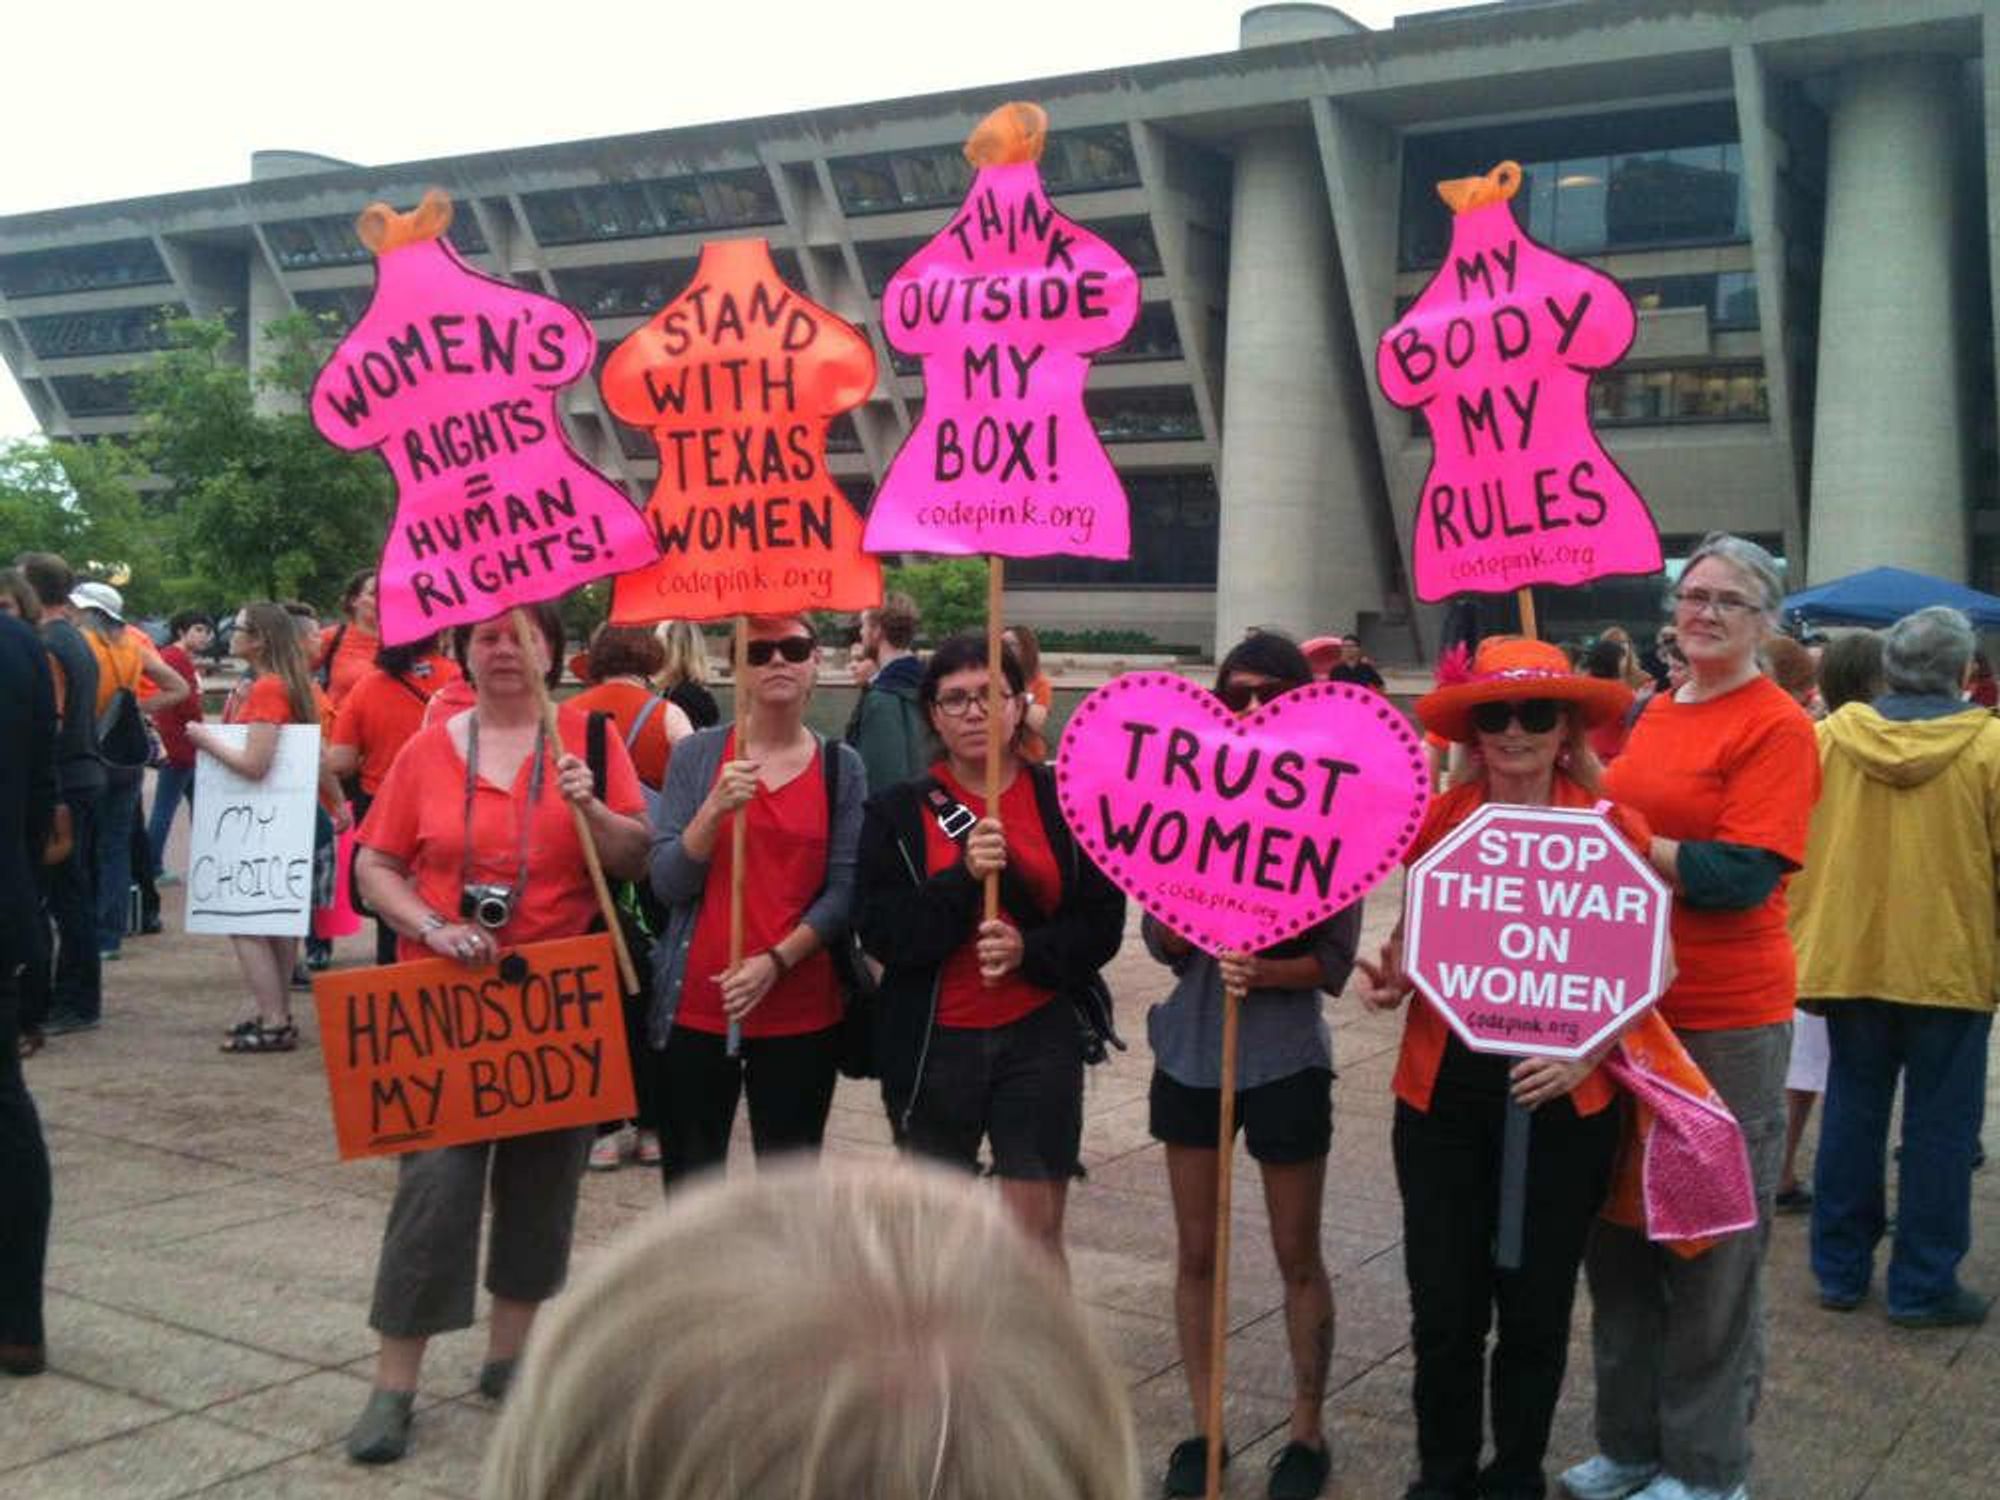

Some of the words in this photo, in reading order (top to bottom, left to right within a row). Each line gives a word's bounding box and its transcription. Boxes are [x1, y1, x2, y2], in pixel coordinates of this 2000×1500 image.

[950, 188, 1077, 271] THINK
[899, 271, 1110, 330] OUTSIDE
[1455, 240, 1517, 301] MY
[664, 282, 817, 356] STAND
[1391, 292, 1592, 384] BODY
[327, 310, 565, 428] WOMEN'S
[643, 357, 795, 415] WITH
[963, 343, 1044, 399] MY
[403, 401, 546, 482] RIGHTS
[935, 414, 1059, 483] BOX!
[1457, 379, 1539, 456] MY
[668, 425, 816, 492] TEXAS
[406, 478, 577, 560] HUMAN
[652, 496, 833, 554] WOMEN
[917, 496, 1096, 544] codepink.org
[1431, 461, 1607, 551] RULES
[411, 514, 615, 617] RIGHTS!
[1122, 722, 1360, 816] TRUST
[214, 804, 276, 846] MY
[1099, 795, 1342, 899] WOMEN
[1477, 828, 1609, 872] STOP
[192, 856, 309, 903] CHOICE
[1430, 871, 1526, 913] THE
[1537, 879, 1650, 924] WAR
[1499, 922, 1570, 963] ON
[346, 979, 512, 1068] HANDS
[521, 965, 603, 1035] OFF
[1437, 962, 1625, 1014] WOMEN
[372, 1069, 444, 1134] MY
[469, 1038, 603, 1119] BODY
